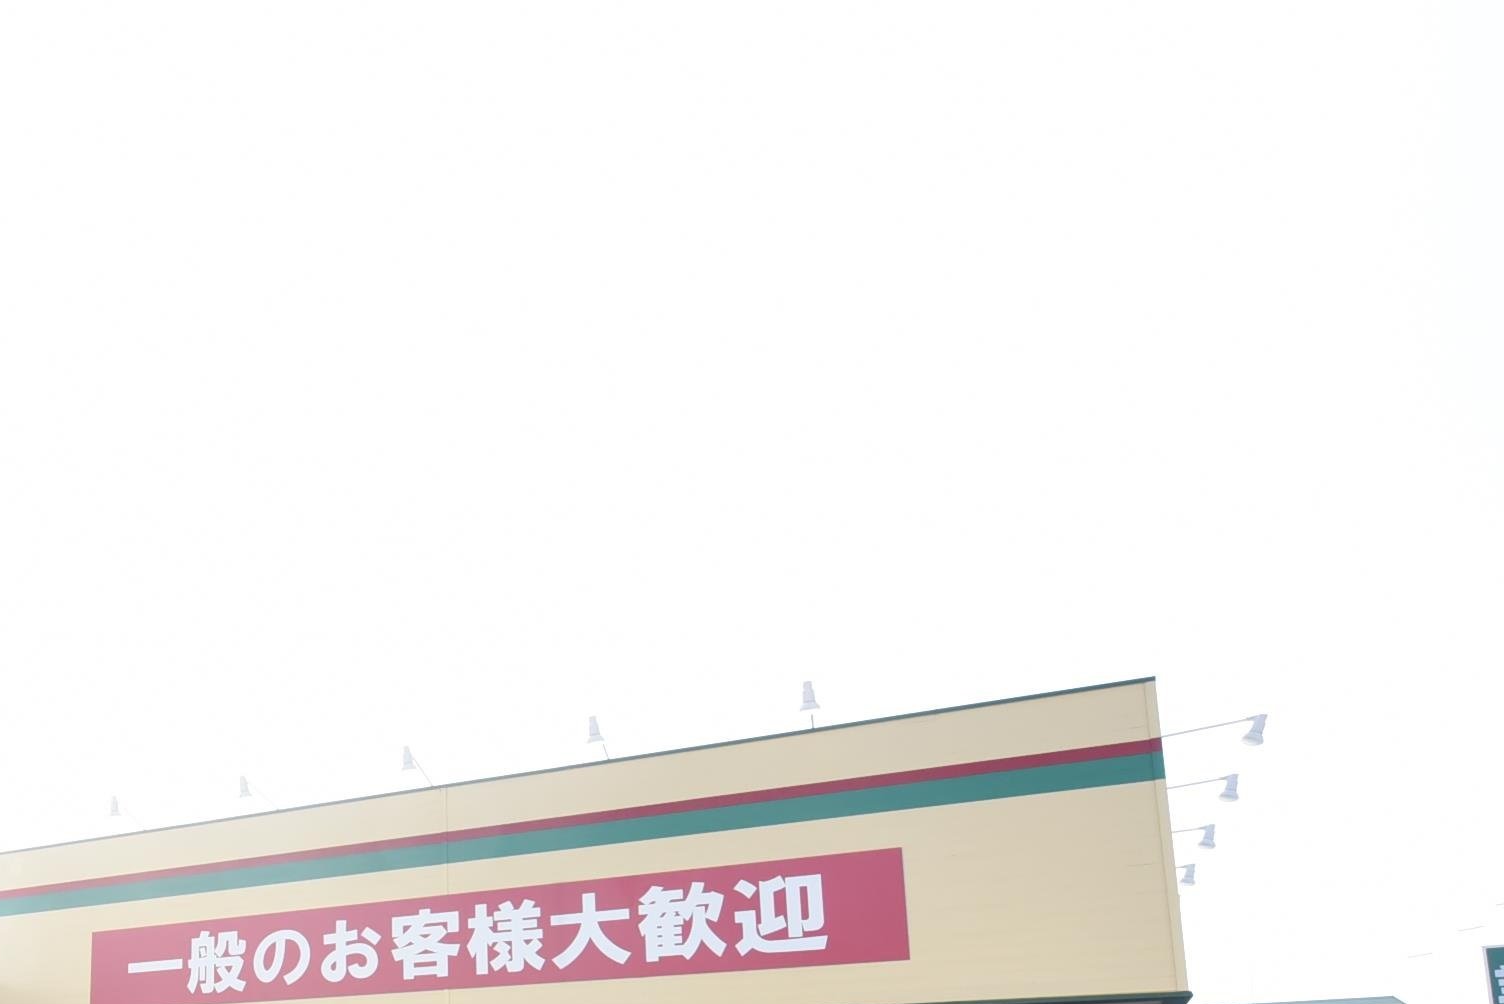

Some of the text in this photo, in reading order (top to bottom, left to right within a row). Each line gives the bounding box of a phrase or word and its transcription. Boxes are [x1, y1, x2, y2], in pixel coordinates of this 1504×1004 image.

[127, 873, 829, 995] 一般のお客様大歓迎
